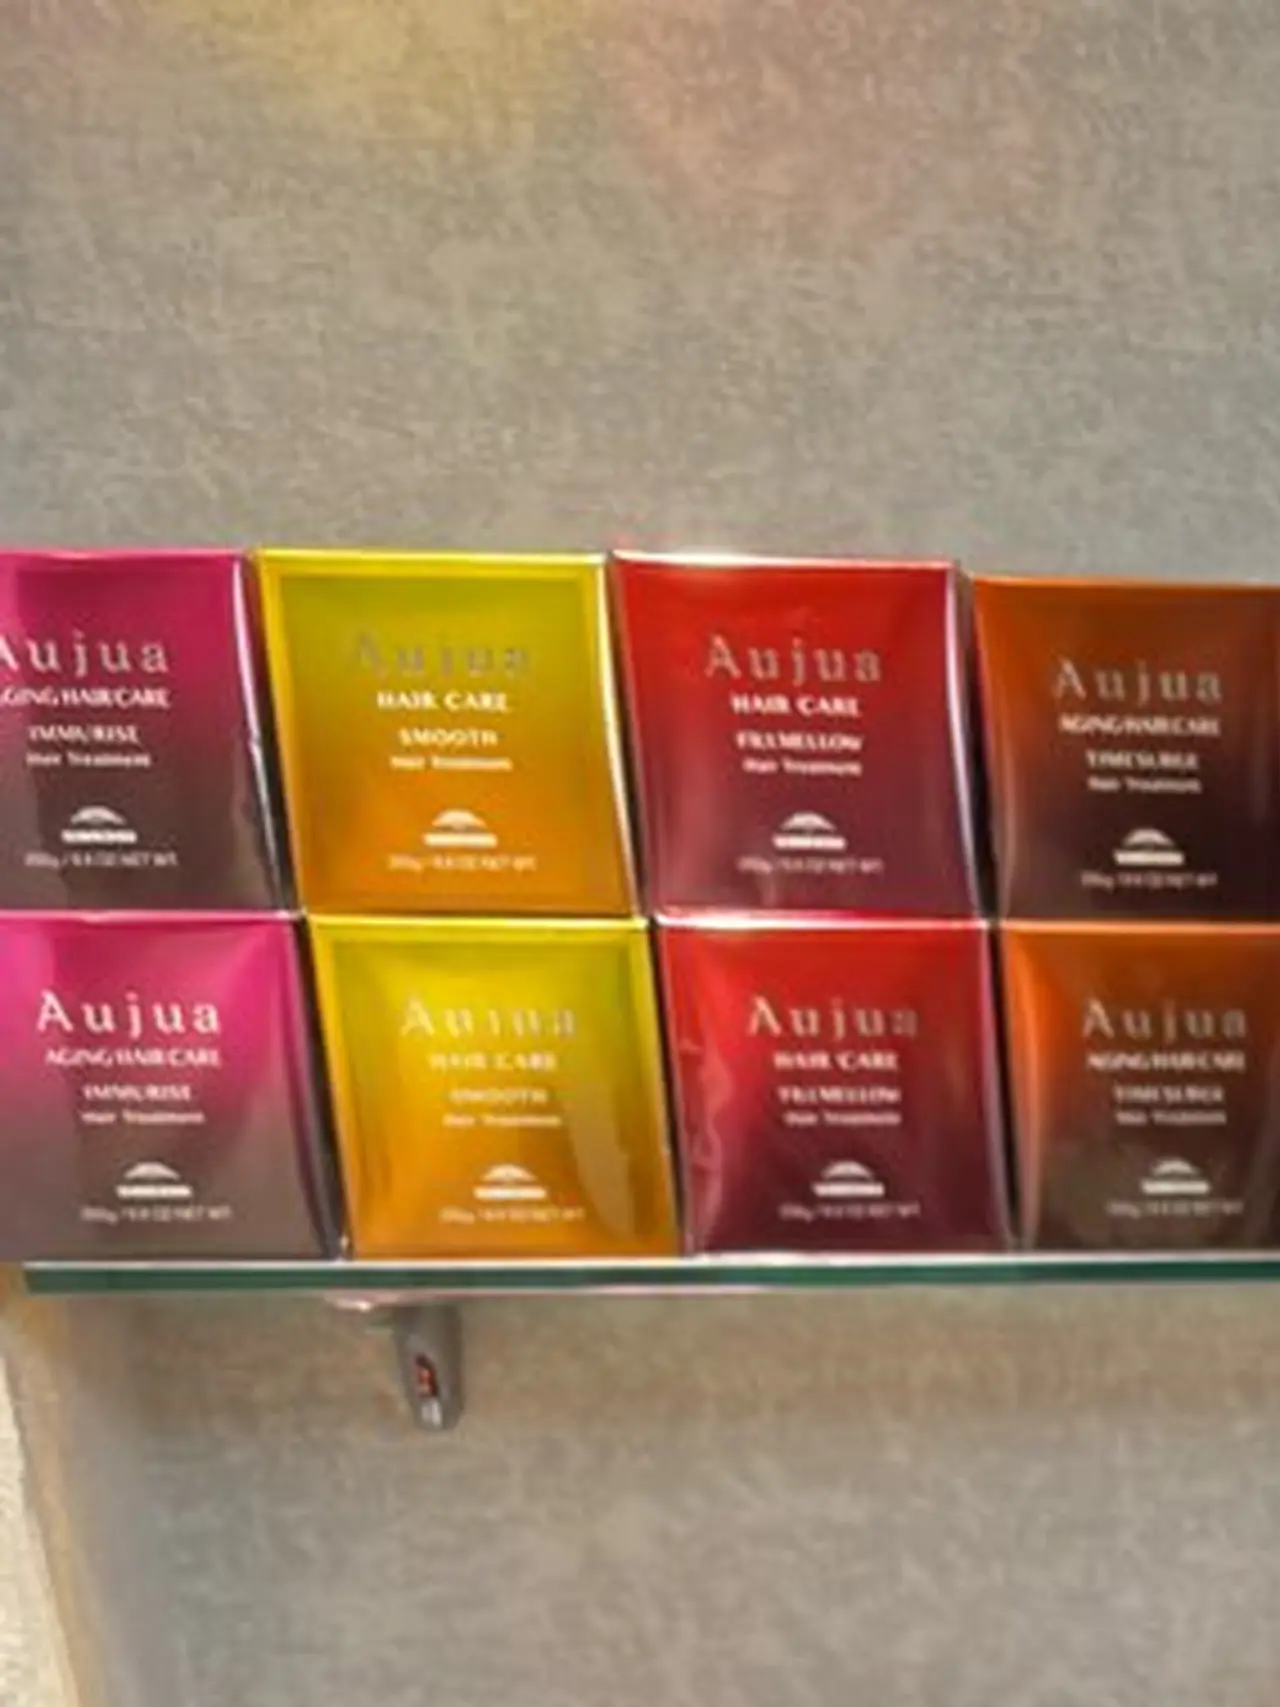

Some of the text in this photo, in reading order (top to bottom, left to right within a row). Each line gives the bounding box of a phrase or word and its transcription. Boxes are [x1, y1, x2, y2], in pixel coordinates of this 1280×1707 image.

[704, 634, 882, 687] Aujua
[1053, 656, 1223, 706] Aujua
[377, 690, 509, 712] HAIR CARE
[730, 692, 861, 717] HAIR CARE
[398, 728, 499, 747] SMOOTH
[37, 988, 221, 1039] Aujua
[400, 996, 576, 1038] Aujua
[747, 995, 919, 1040] Aujua
[1082, 997, 1246, 1045] Aujua
[494, 1051, 557, 1073] CARE
[773, 1051, 899, 1071] HAIR CARE
